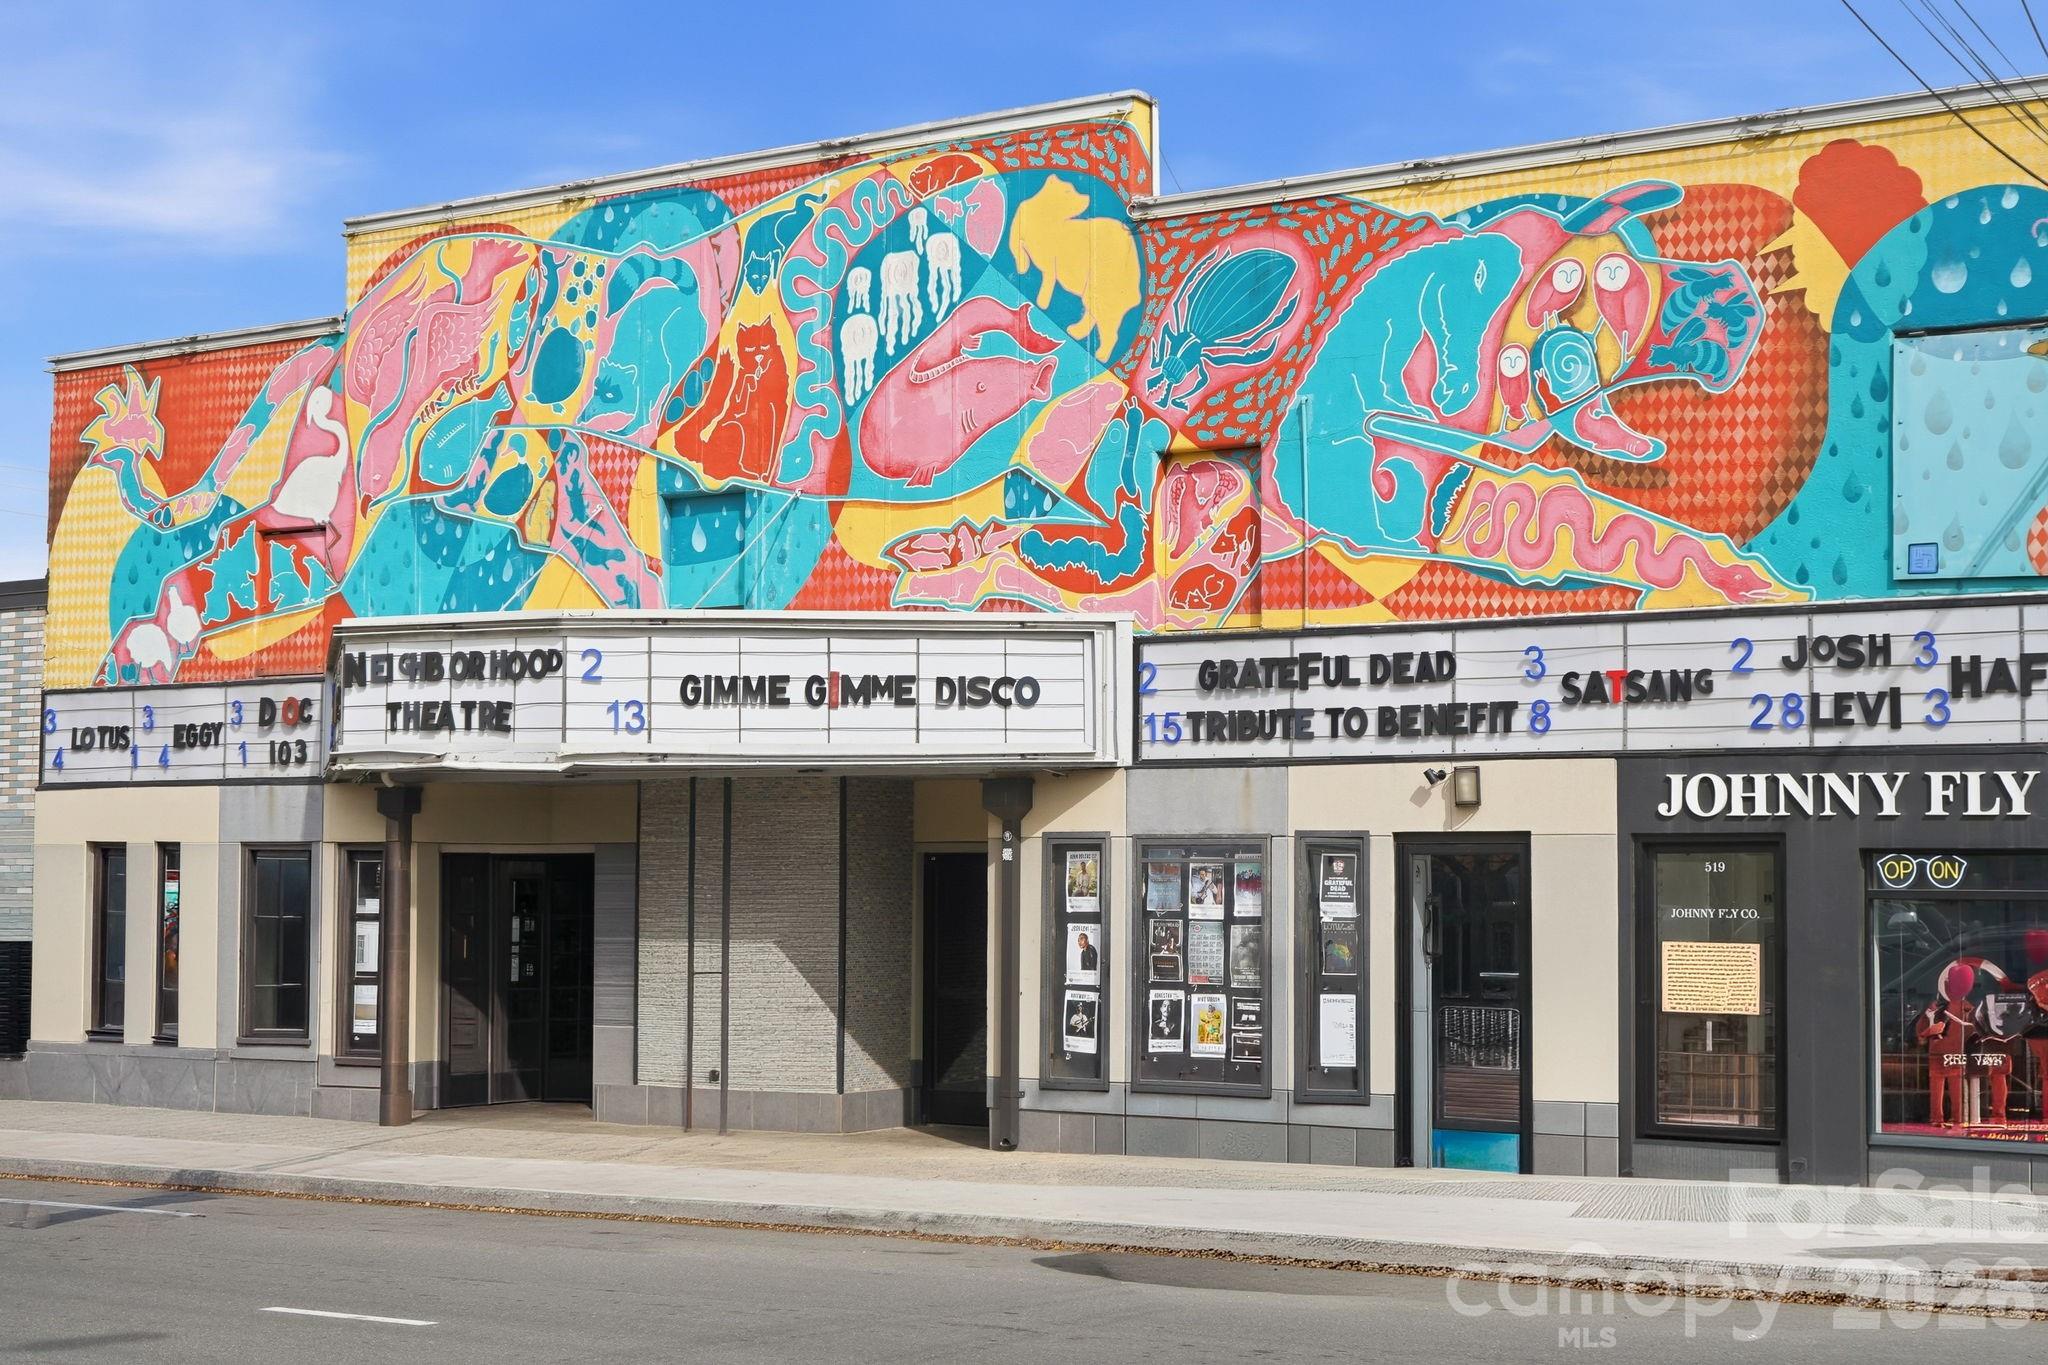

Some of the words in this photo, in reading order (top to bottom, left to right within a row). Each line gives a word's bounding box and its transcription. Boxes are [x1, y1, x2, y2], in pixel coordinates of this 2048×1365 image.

[581, 648, 602, 682] 2
[1524, 645, 1546, 680] 3
[1731, 637, 1754, 673] 2
[1781, 633, 1891, 670] JOSH
[1914, 631, 1939, 668] 3
[344, 649, 563, 687] NEIGHBORHOOD
[1139, 662, 1157, 694] 2
[1199, 652, 1360, 691] GRATEFUL
[1370, 650, 1456, 684] DEAD
[1950, 653, 2048, 698] HAF
[680, 674, 790, 706] GIMME
[805, 671, 916, 709] GIMME
[936, 675, 1041, 706] DISCO
[1562, 668, 1713, 704] SATSANG
[44, 709, 57, 734] 3
[143, 705, 154, 730] 3
[231, 700, 243, 725] 3
[259, 696, 313, 727] DOC
[386, 700, 512, 732] THEATRE
[607, 700, 646, 734] 13
[1186, 708, 1315, 742] TRIBUTE
[1325, 707, 1368, 739] TO
[1378, 700, 1518, 737] BENEFIT
[1530, 700, 1551, 733] 8
[1750, 692, 1805, 729] 28
[1810, 686, 1901, 729] LEVI
[1925, 687, 1951, 727] 3
[71, 725, 130, 750] LOTUS
[173, 721, 223, 748] EGGY
[1144, 712, 1182, 744] 15
[53, 747, 64, 770] 4
[269, 739, 307, 765] 103
[1657, 771, 1909, 818] JOHNNY
[1924, 770, 2040, 816] FLY
[1704, 861, 1726, 873] 519
[1671, 908, 1715, 919] JOHNNY
[1740, 908, 1760, 919] CO.
